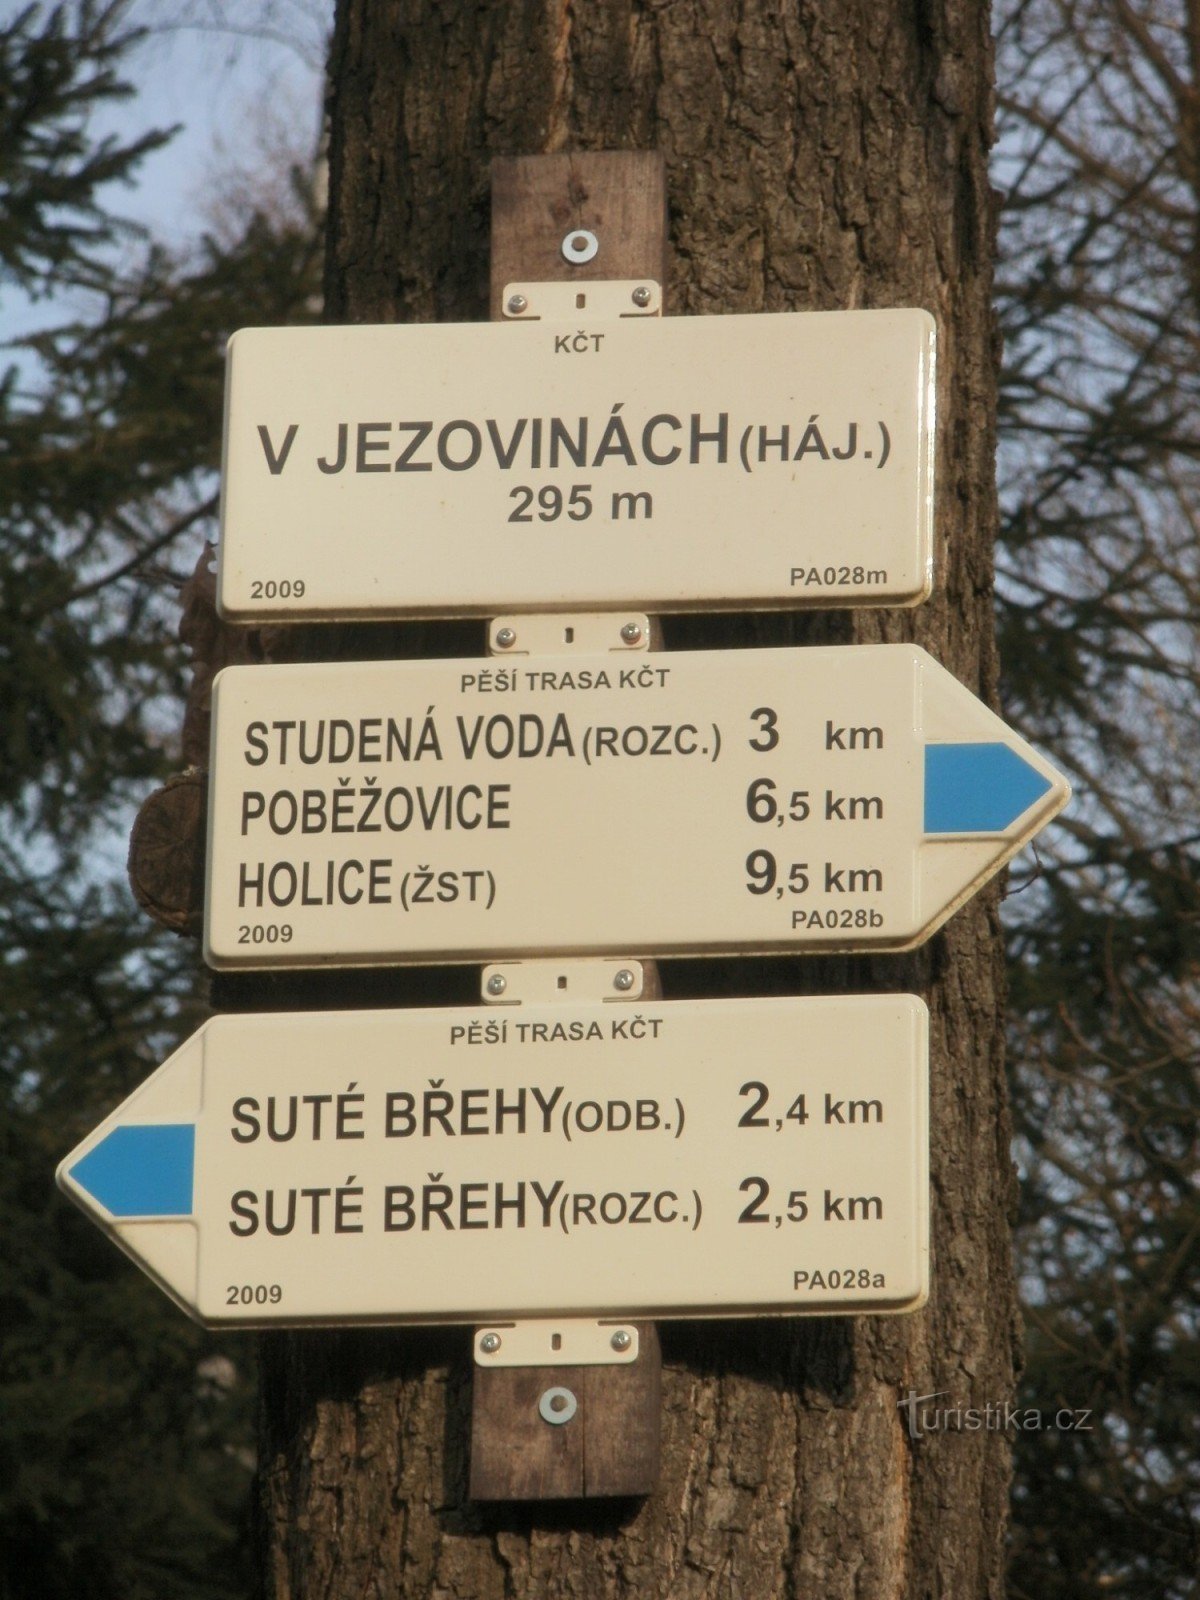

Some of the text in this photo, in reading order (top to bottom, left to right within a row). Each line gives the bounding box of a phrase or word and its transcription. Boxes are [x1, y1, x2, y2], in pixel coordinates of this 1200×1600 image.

[554, 329, 605, 354] KČT
[256, 402, 891, 475] V JEZOVINÁCH (HÁJ.)
[507, 484, 653, 523] 295 m
[251, 579, 306, 599] 2009
[790, 565, 887, 586] PA028m
[461, 664, 671, 693] PĚŠÍ TRASA KČT
[244, 704, 884, 768] STUDENÁ VODA (ROZC.) 3 km
[241, 776, 883, 837] POBĚŽOVICE 6,5 km
[238, 849, 883, 912] HOLICE (ŽST) 9,5 km
[792, 908, 884, 929] PA028b
[239, 924, 293, 944] 2009
[450, 1013, 664, 1045] PĚŠÍ TRASA KČT
[230, 1081, 365, 1144] SUTÉ
[737, 1080, 809, 1132] 2,4
[824, 1093, 883, 1126] km
[228, 1175, 364, 1238] SUTÉ
[737, 1176, 809, 1229] 2,5
[823, 1189, 883, 1221] km
[226, 1284, 282, 1305] 2009
[793, 1269, 885, 1290] PA028a
